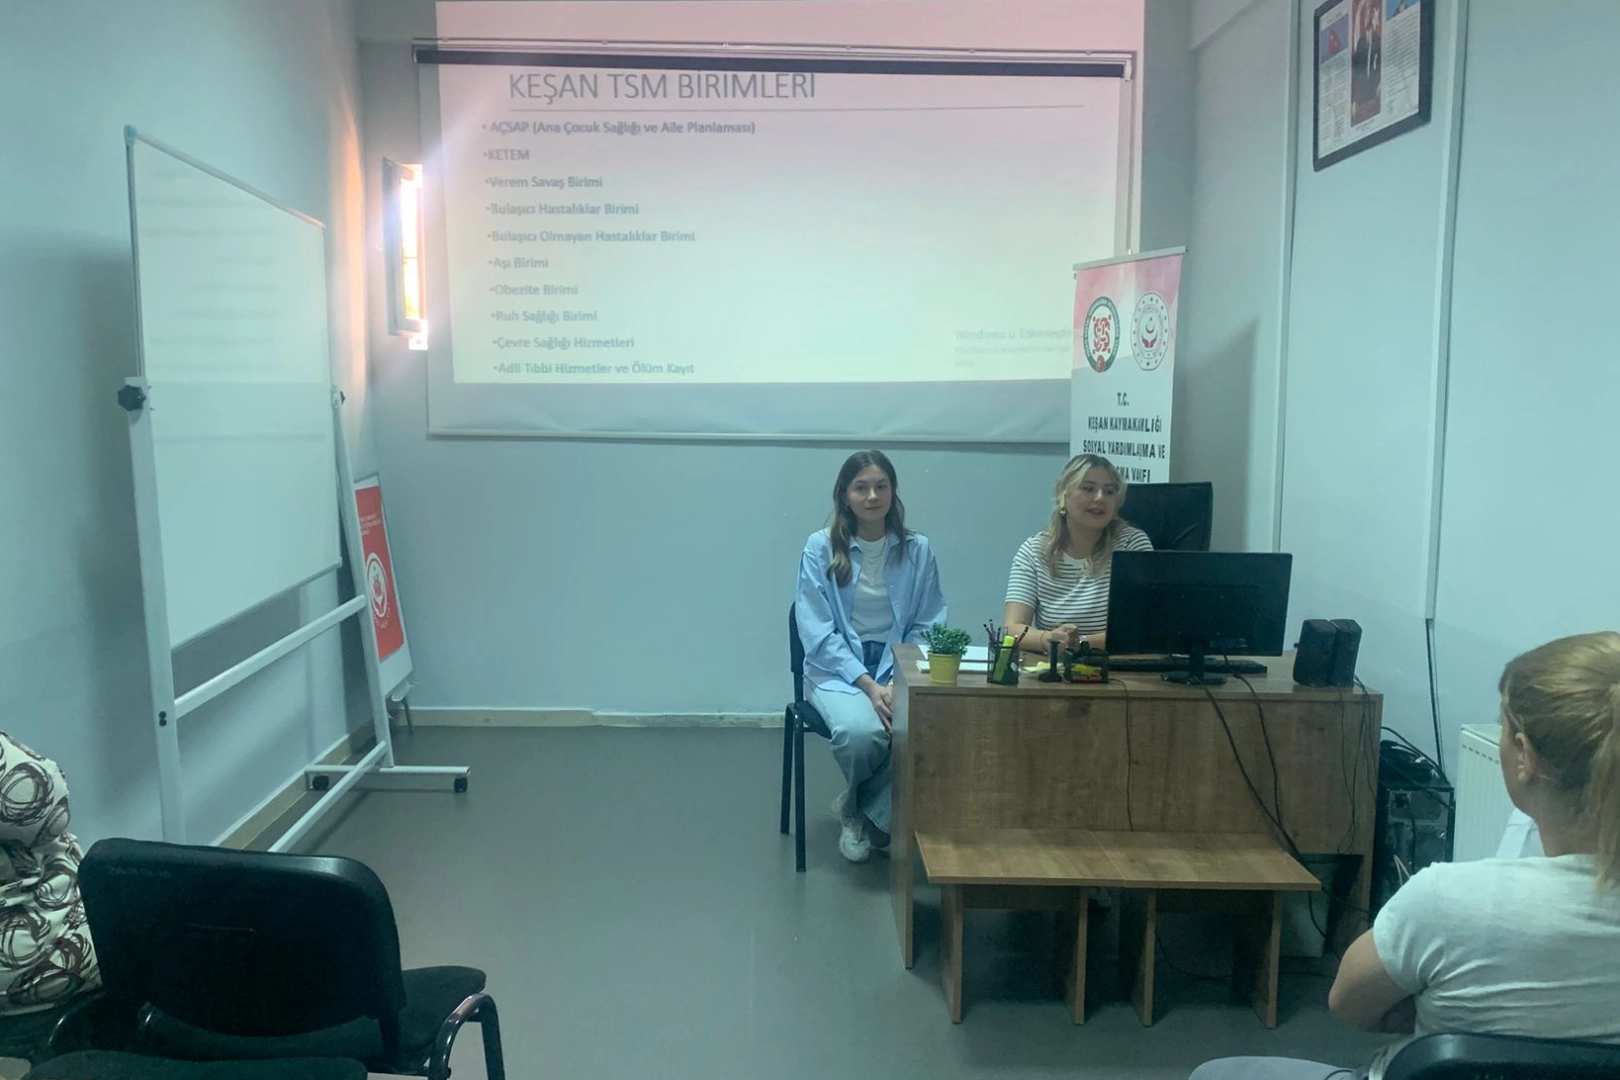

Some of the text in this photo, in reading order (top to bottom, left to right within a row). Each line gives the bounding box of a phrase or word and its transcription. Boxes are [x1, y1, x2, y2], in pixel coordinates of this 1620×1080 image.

[509, 73, 599, 104] KEŞAN
[607, 73, 668, 99] TSM
[490, 121, 756, 136] AÇSAP (Ana Çocuk Sağlığı ve Aile Planlaması)
[488, 149, 530, 161] KETEM
[490, 176, 603, 190] Verem Savaş Birimi
[491, 203, 639, 217] Bulaşıcı Hastalıklar Birimi
[492, 231, 695, 244] Bulaşıcı Olmayan Hastalıklar Birimi
[493, 257, 549, 270] Aşı Birimi
[494, 284, 578, 296] Obezite Birimi
[496, 310, 598, 325] Ruh Sağlığı Birimi
[497, 336, 634, 351] Çevre Sağlığı Hizmetleri
[499, 362, 521, 374] Adli
[555, 362, 612, 374] Hizmetler
[615, 365, 629, 374] ve
[632, 360, 664, 374] Ölüm
[666, 363, 695, 376] Kayıt
[1116, 392, 1130, 406] T.C.
[1087, 416, 1108, 433] KEŞAN
[1082, 440, 1106, 454] SOSYAL
